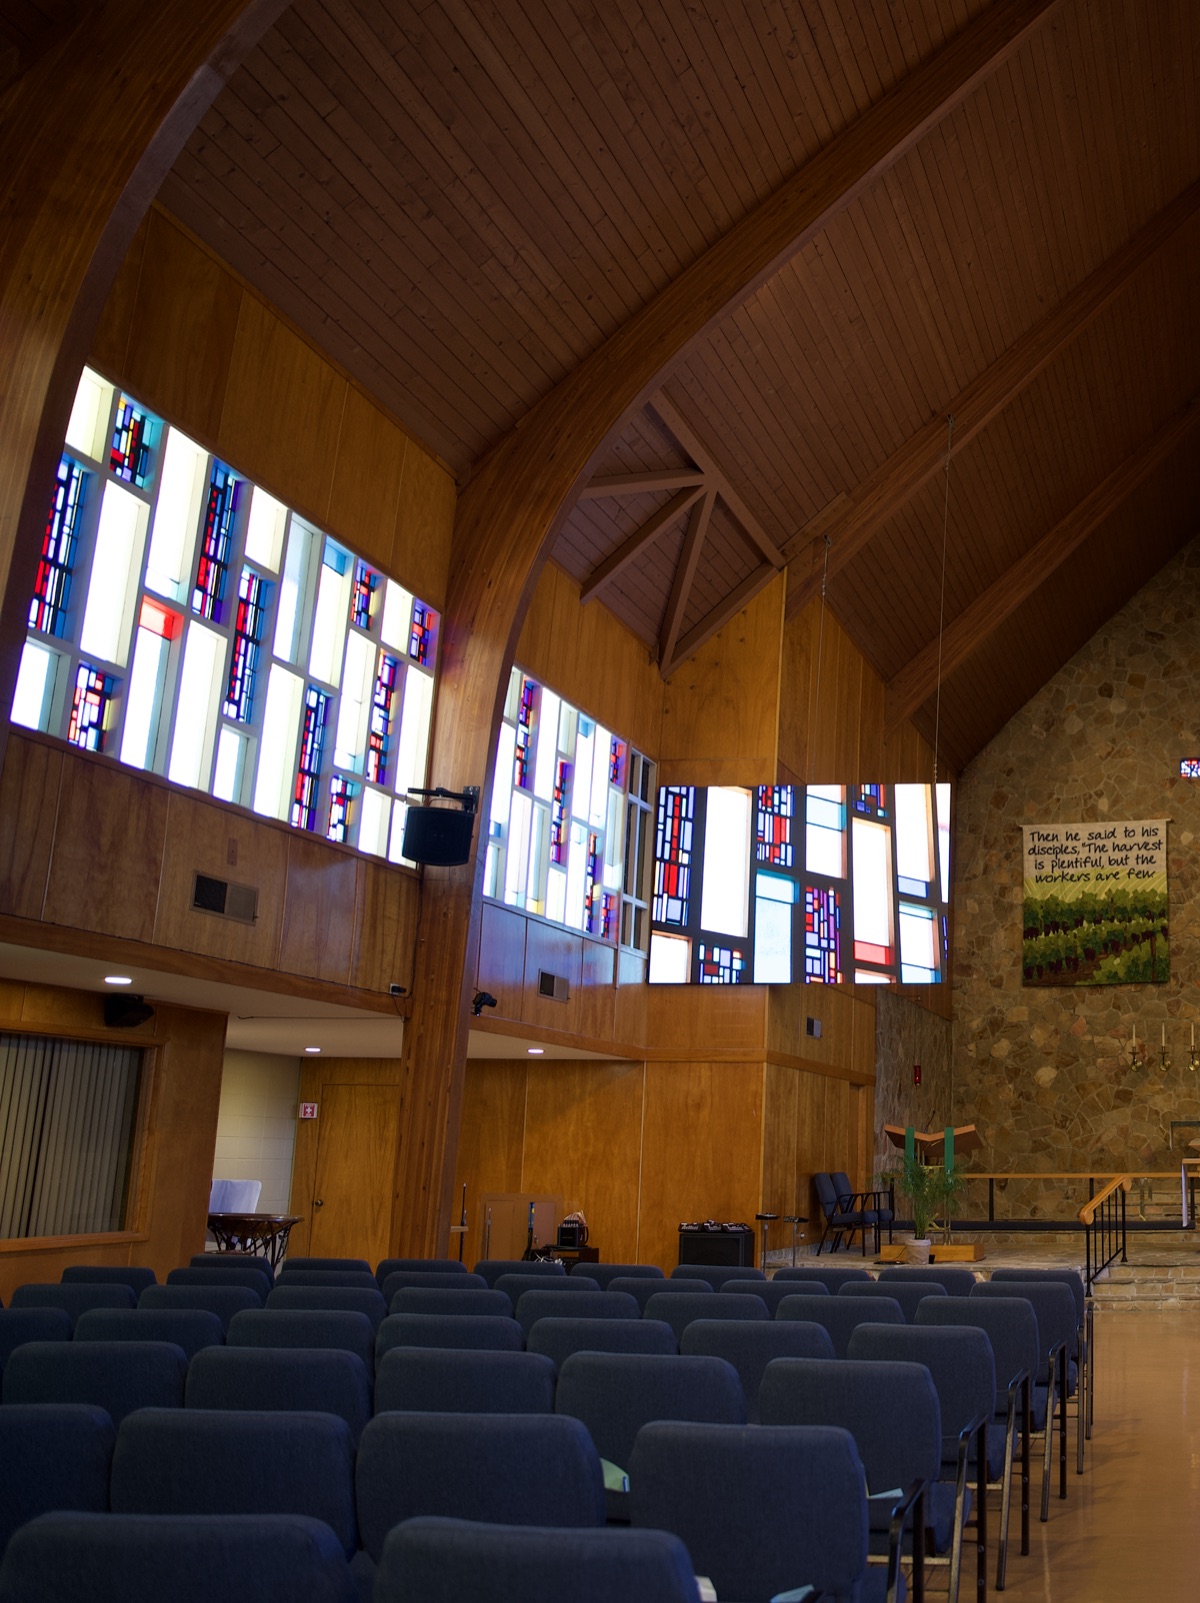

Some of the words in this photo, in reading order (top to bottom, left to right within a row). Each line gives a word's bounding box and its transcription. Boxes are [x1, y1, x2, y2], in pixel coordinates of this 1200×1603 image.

[1030, 831, 1059, 842] Then
[1066, 831, 1080, 841] he
[1087, 828, 1116, 841] said
[1124, 827, 1135, 838] to
[1141, 827, 1159, 837] his
[1028, 844, 1080, 859] disciples,
[1082, 842, 1108, 853] "The
[1113, 840, 1163, 852] harvest
[1035, 860, 1044, 870] is
[1051, 857, 1104, 873] plentiful,
[1108, 856, 1130, 866] but
[1136, 854, 1156, 864] the
[1035, 871, 1090, 883] workers
[1096, 871, 1119, 881] are
